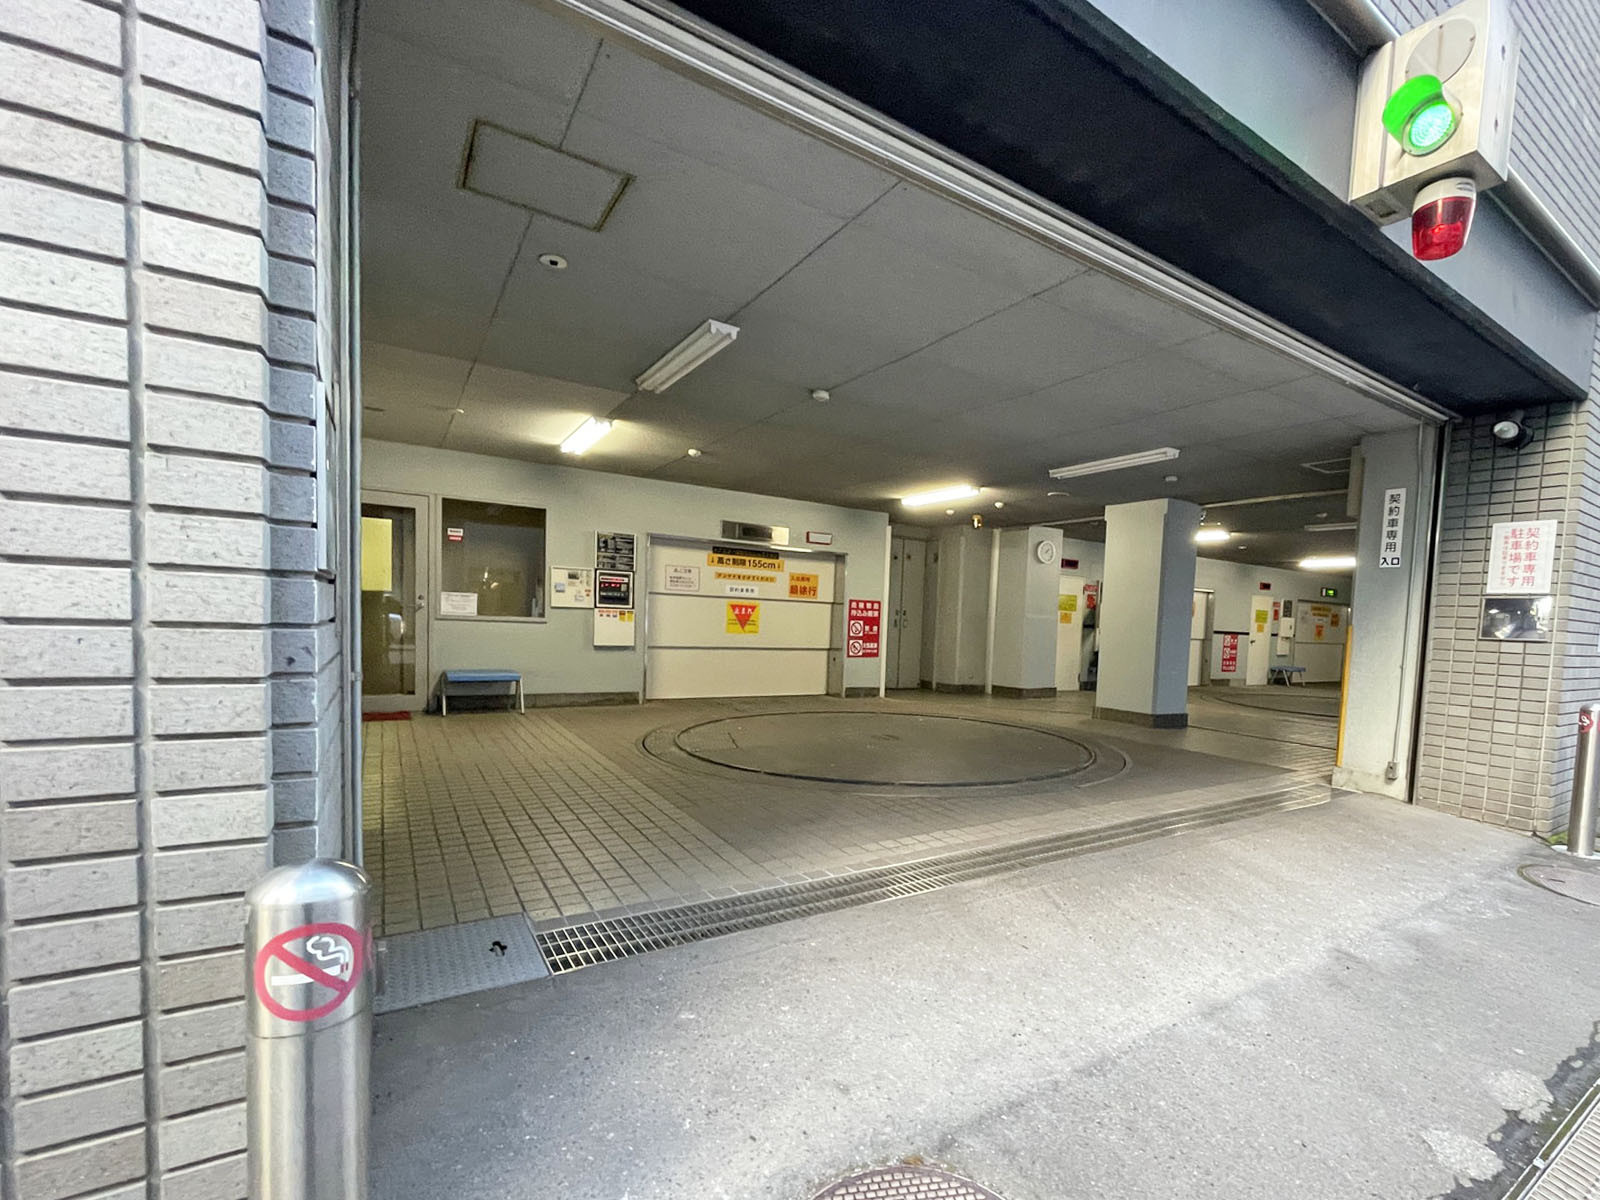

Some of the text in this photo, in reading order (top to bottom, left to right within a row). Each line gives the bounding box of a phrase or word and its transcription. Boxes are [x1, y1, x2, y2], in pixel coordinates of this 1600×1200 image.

[1384, 493, 1401, 553] 契約車専用
[717, 556, 776, 569] 高さ制限155cm
[1381, 556, 1400, 566] 入口
[1507, 528, 1524, 588] 駐車場です
[1521, 527, 1540, 587] 契約車専用
